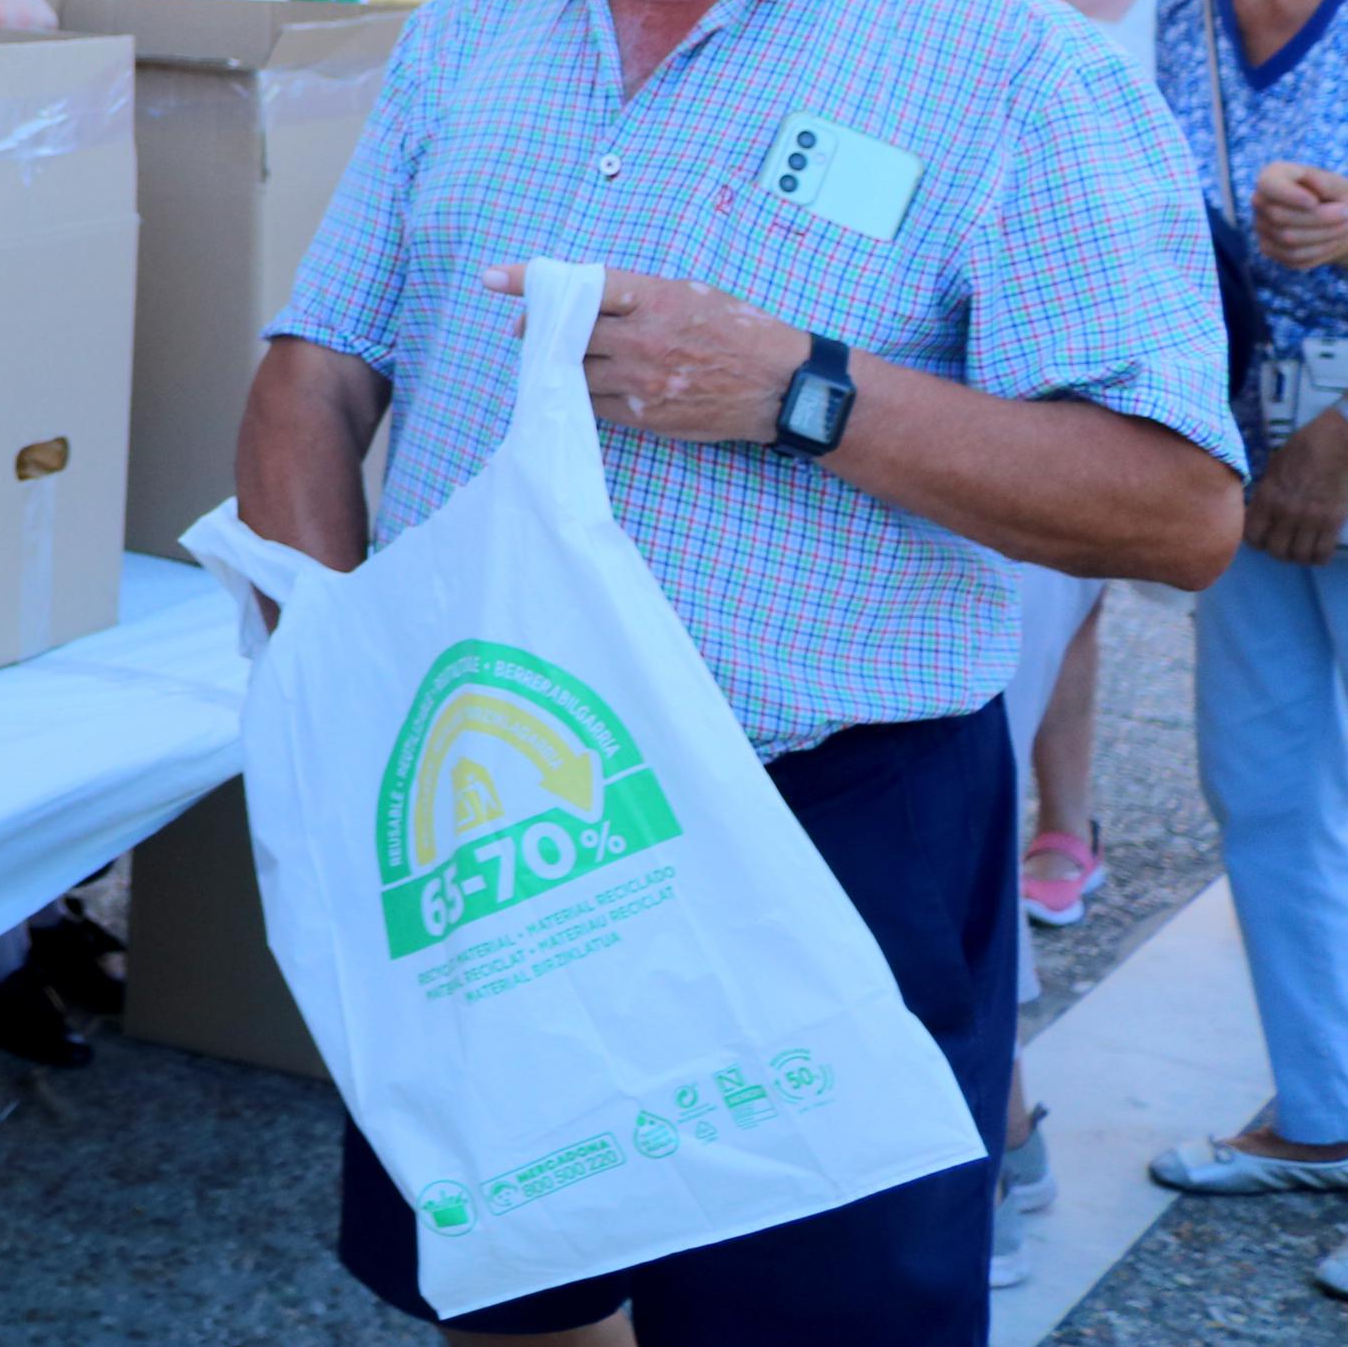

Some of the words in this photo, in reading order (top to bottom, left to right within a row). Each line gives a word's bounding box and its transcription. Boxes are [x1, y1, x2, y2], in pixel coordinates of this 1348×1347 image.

[494, 661, 622, 759] BERRERABILGARRIA
[526, 898, 595, 936] MATERIAL
[596, 864, 676, 906] RECICLADO
[609, 885, 675, 923] RECICLAT
[464, 969, 531, 1004] MATERIAL
[516, 1139, 610, 1184] MERCADONA
